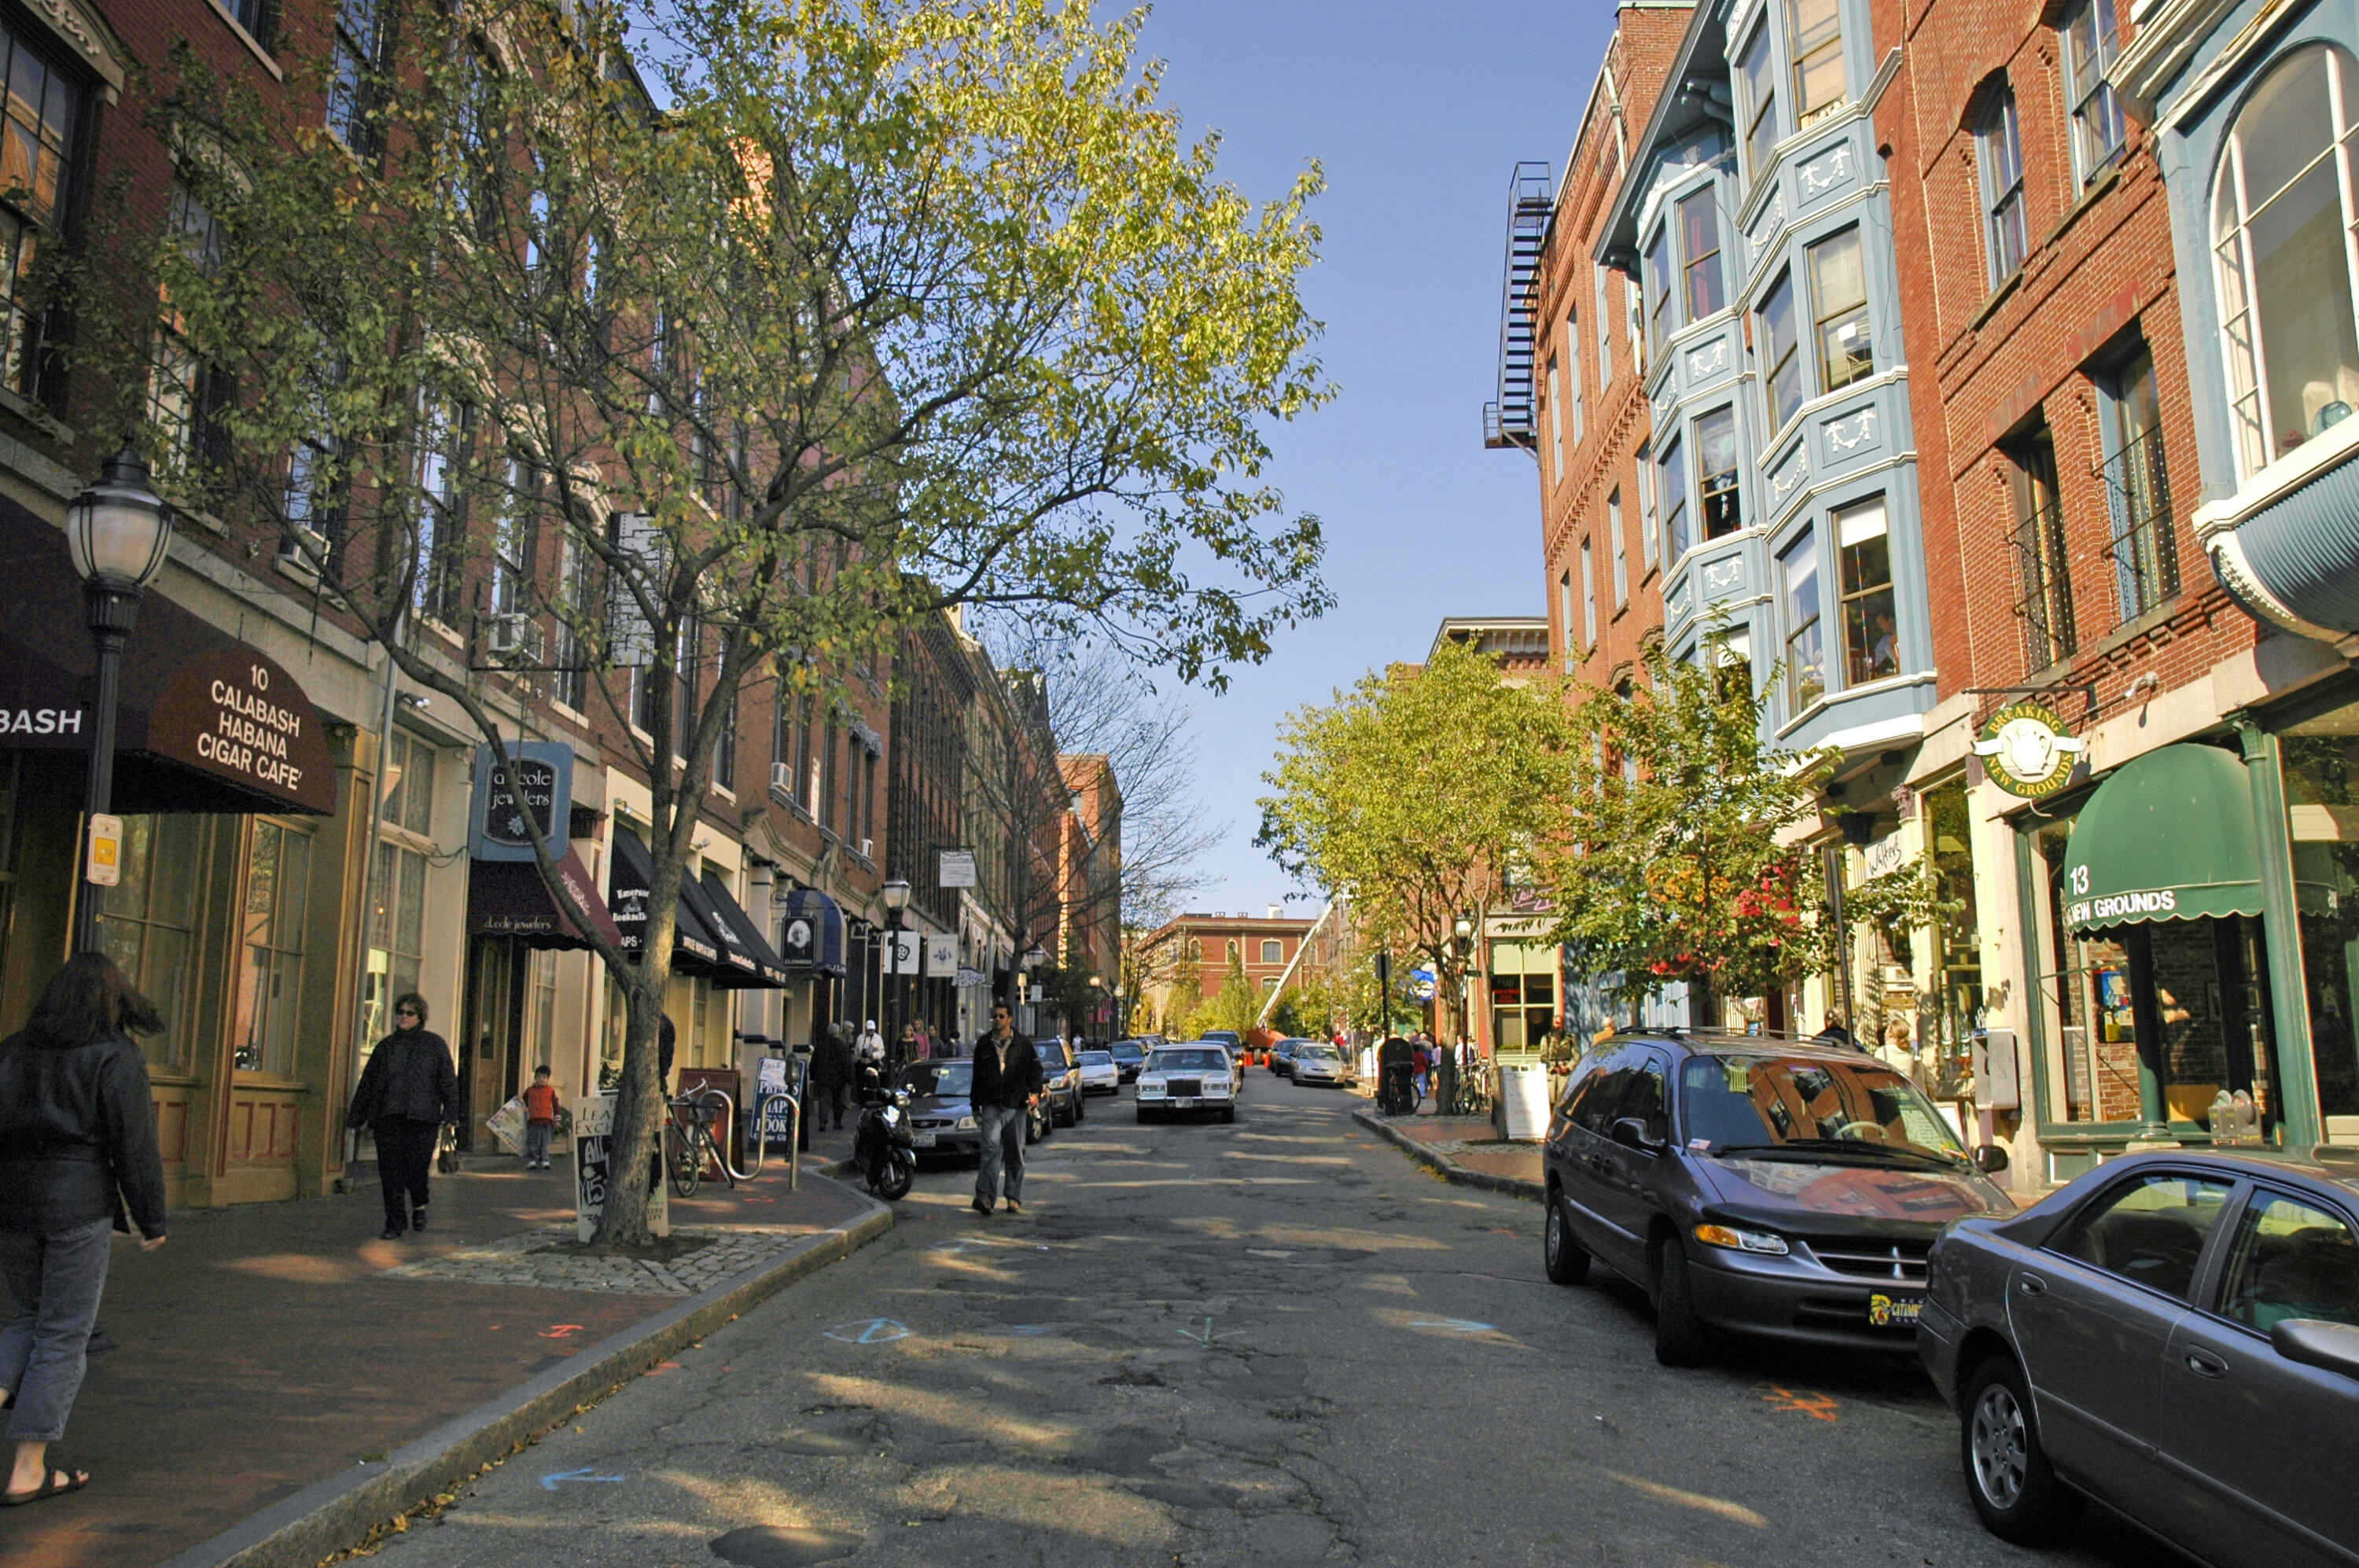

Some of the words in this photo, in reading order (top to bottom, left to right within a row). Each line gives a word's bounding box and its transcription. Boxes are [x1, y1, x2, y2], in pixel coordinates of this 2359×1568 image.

[250, 664, 269, 691] 10
[212, 679, 300, 738] CALABASH
[1988, 705, 2063, 734] BREAKING
[219, 711, 287, 760] HABANA
[197, 732, 252, 773] CIGAR
[1986, 756, 2013, 787] NEW
[2015, 753, 2073, 796] GROUNDS
[491, 790, 550, 810] jewlers
[2070, 864, 2089, 896] 13
[613, 912, 647, 922] Booksell
[2070, 900, 2092, 925] NEW
[2094, 890, 2177, 918] GROUNDS
[759, 1080, 800, 1096] PRINS
